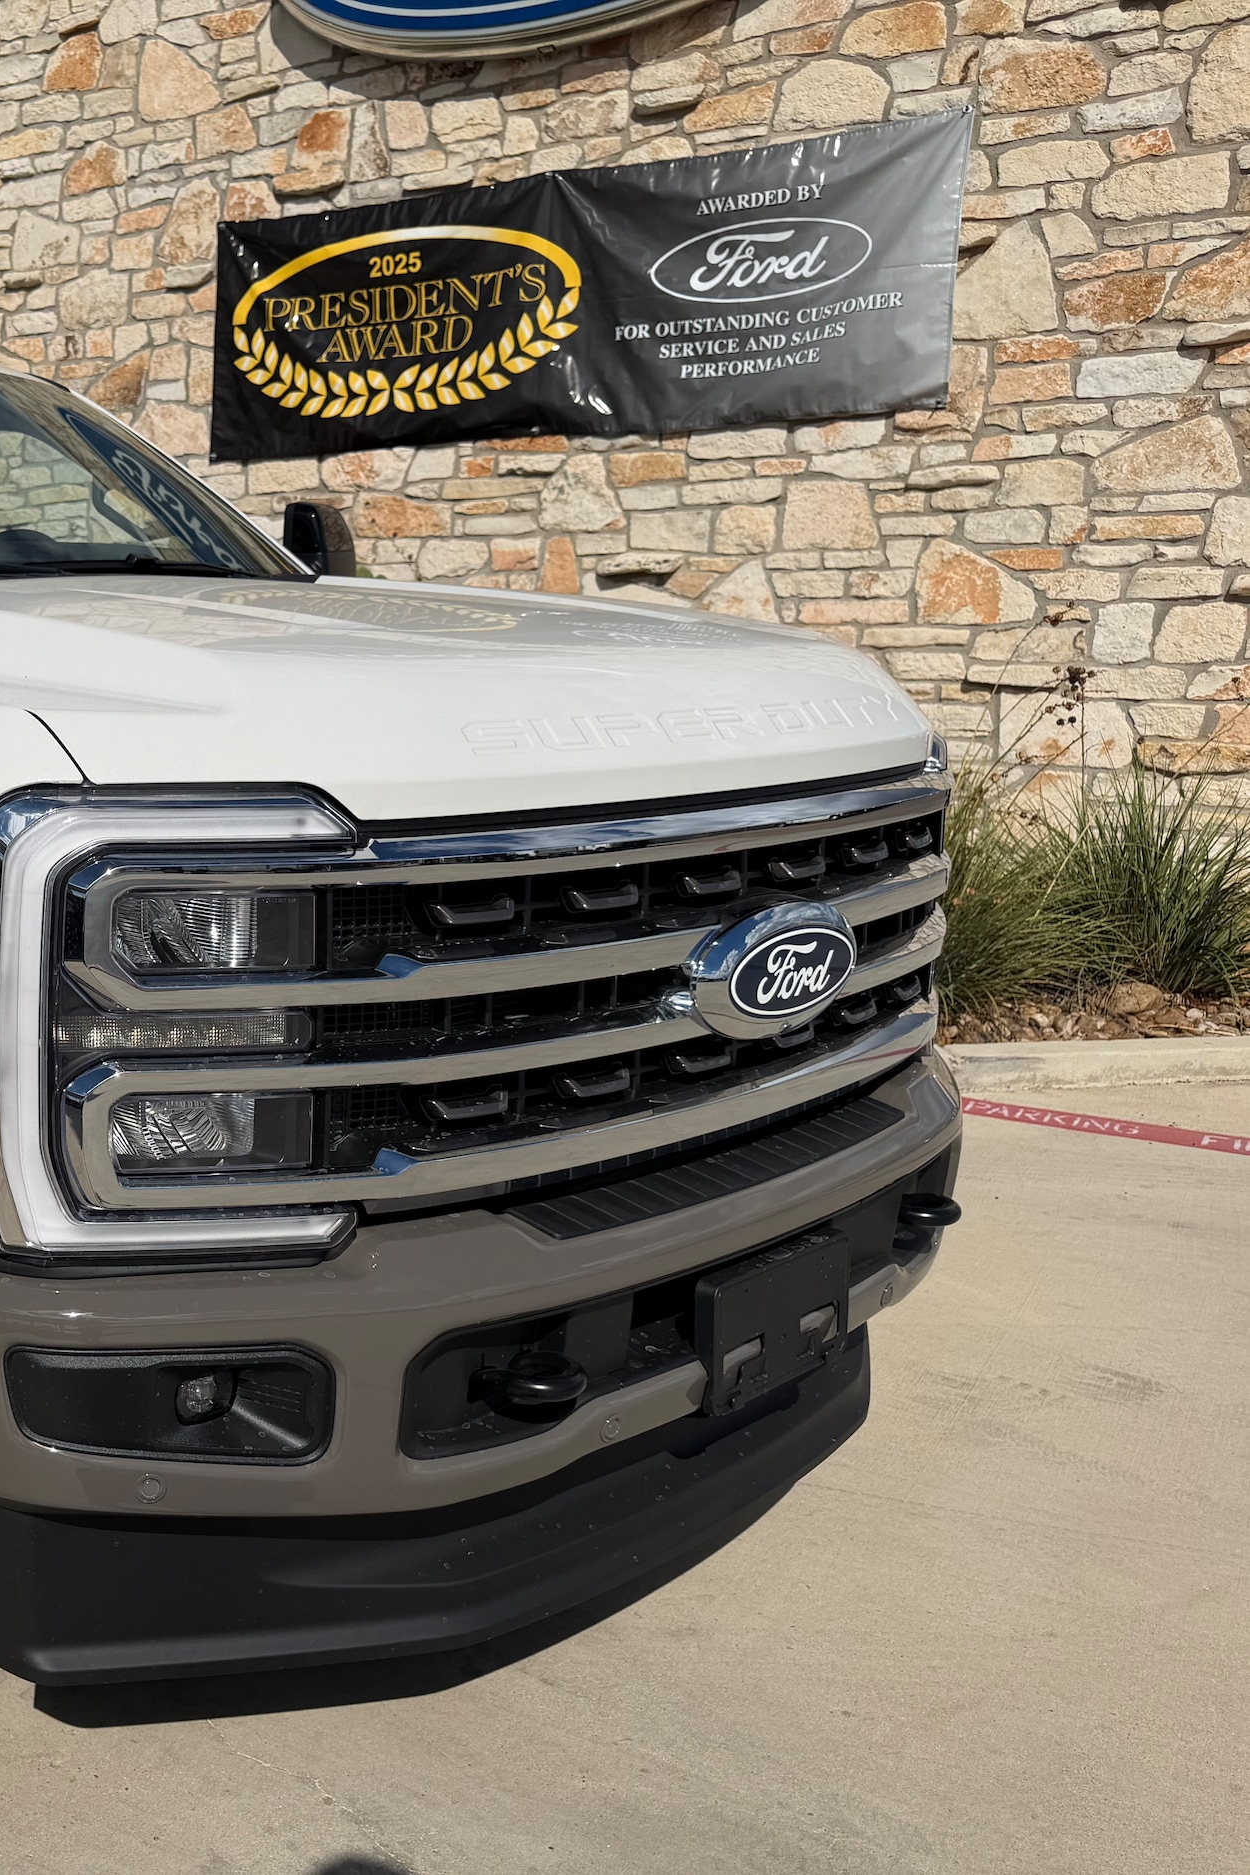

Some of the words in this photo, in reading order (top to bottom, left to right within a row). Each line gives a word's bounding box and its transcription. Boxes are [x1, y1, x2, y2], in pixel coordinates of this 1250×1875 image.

[696, 188, 791, 216] AWARDED
[796, 183, 826, 201] BY
[369, 252, 422, 278] 2025
[689, 229, 830, 292] Ford
[263, 263, 548, 333] PRESIDENT'S
[614, 323, 651, 342] FOR
[655, 310, 791, 338] OUTSTANDING
[796, 291, 903, 325] CUSTOMER
[316, 316, 474, 363] AWARD
[658, 338, 740, 360] SERVICE
[745, 333, 787, 352] AND
[790, 321, 847, 347] SALES
[679, 347, 821, 379] PERFORMANCE
[461, 706, 764, 757] SUPER
[760, 692, 902, 736] DUTY
[756, 941, 835, 1005] Ford
[963, 1100, 1139, 1136] PARKING
